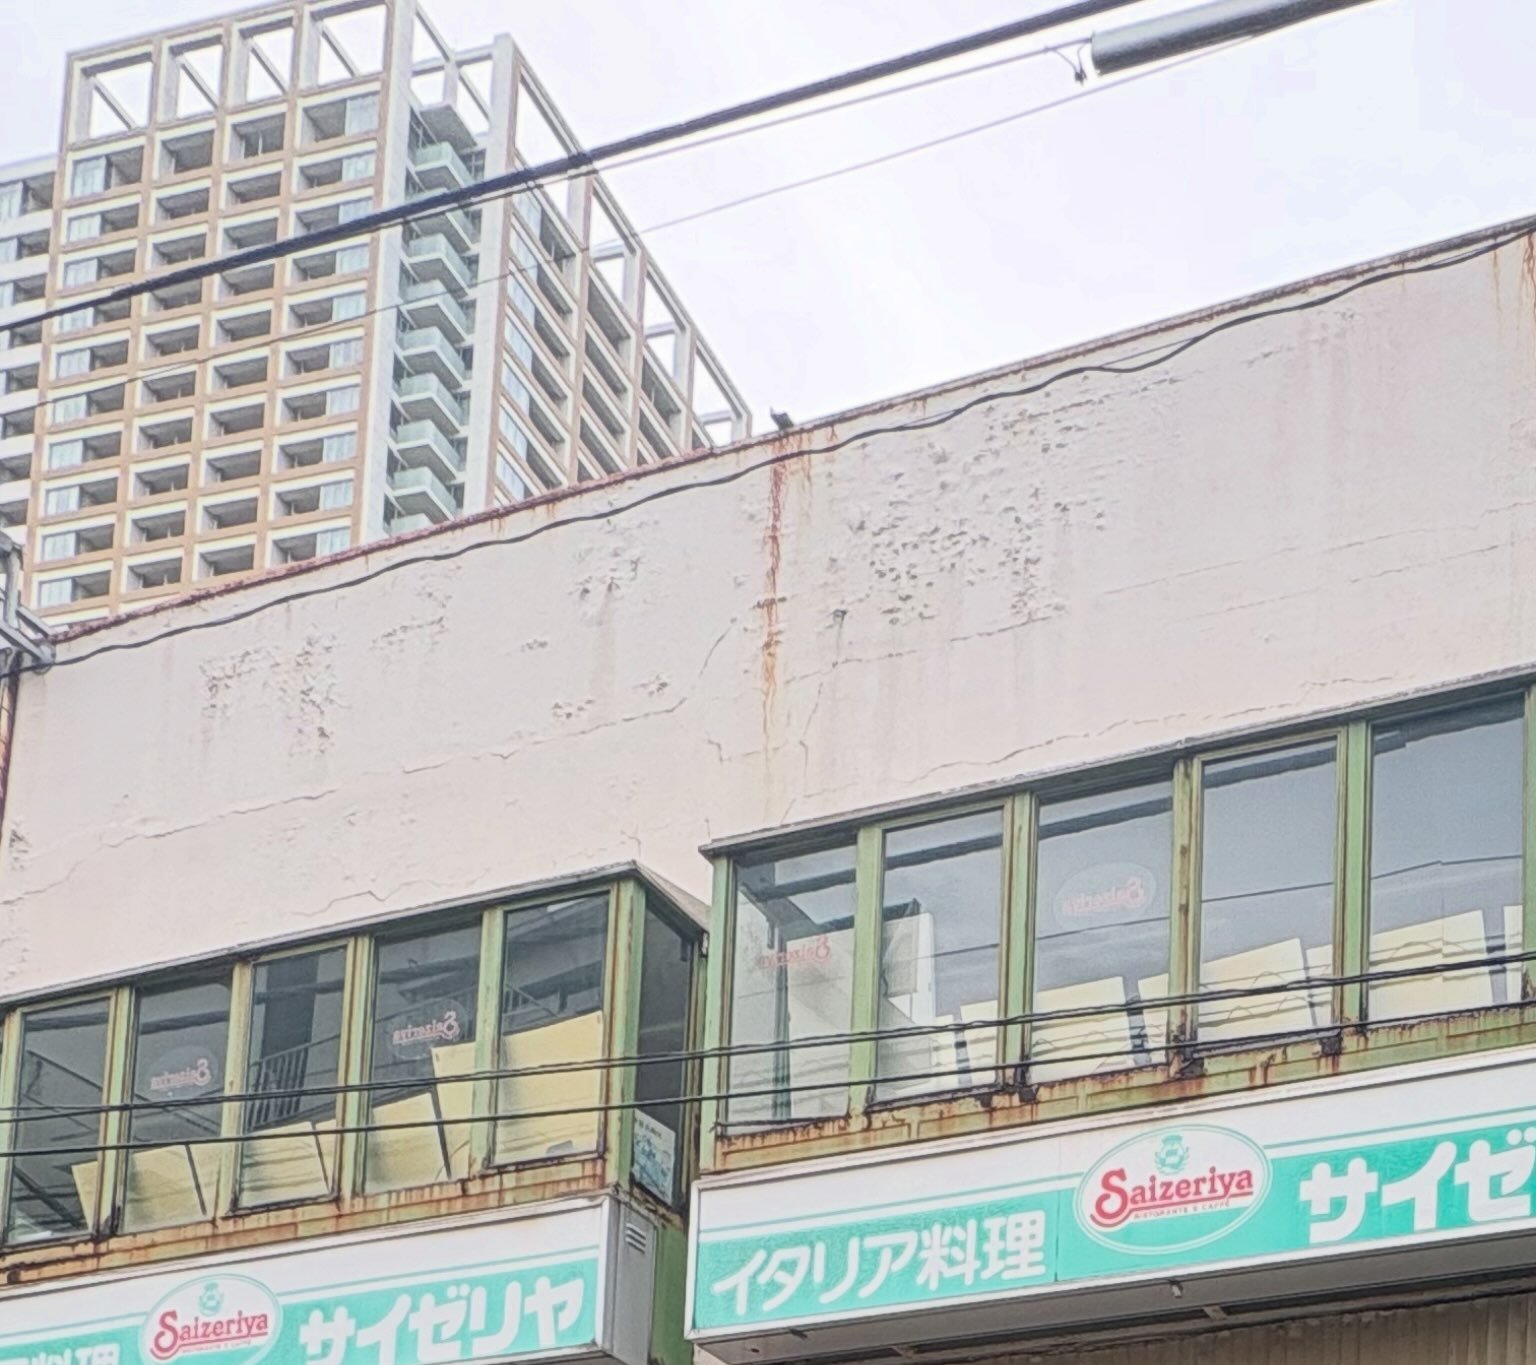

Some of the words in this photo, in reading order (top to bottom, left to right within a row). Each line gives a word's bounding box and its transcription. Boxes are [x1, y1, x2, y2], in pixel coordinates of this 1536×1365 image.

[1090, 1166, 1254, 1228] Saizeriya
[711, 1209, 1047, 1316] イタリア料理
[150, 1310, 269, 1360] Saizeriya
